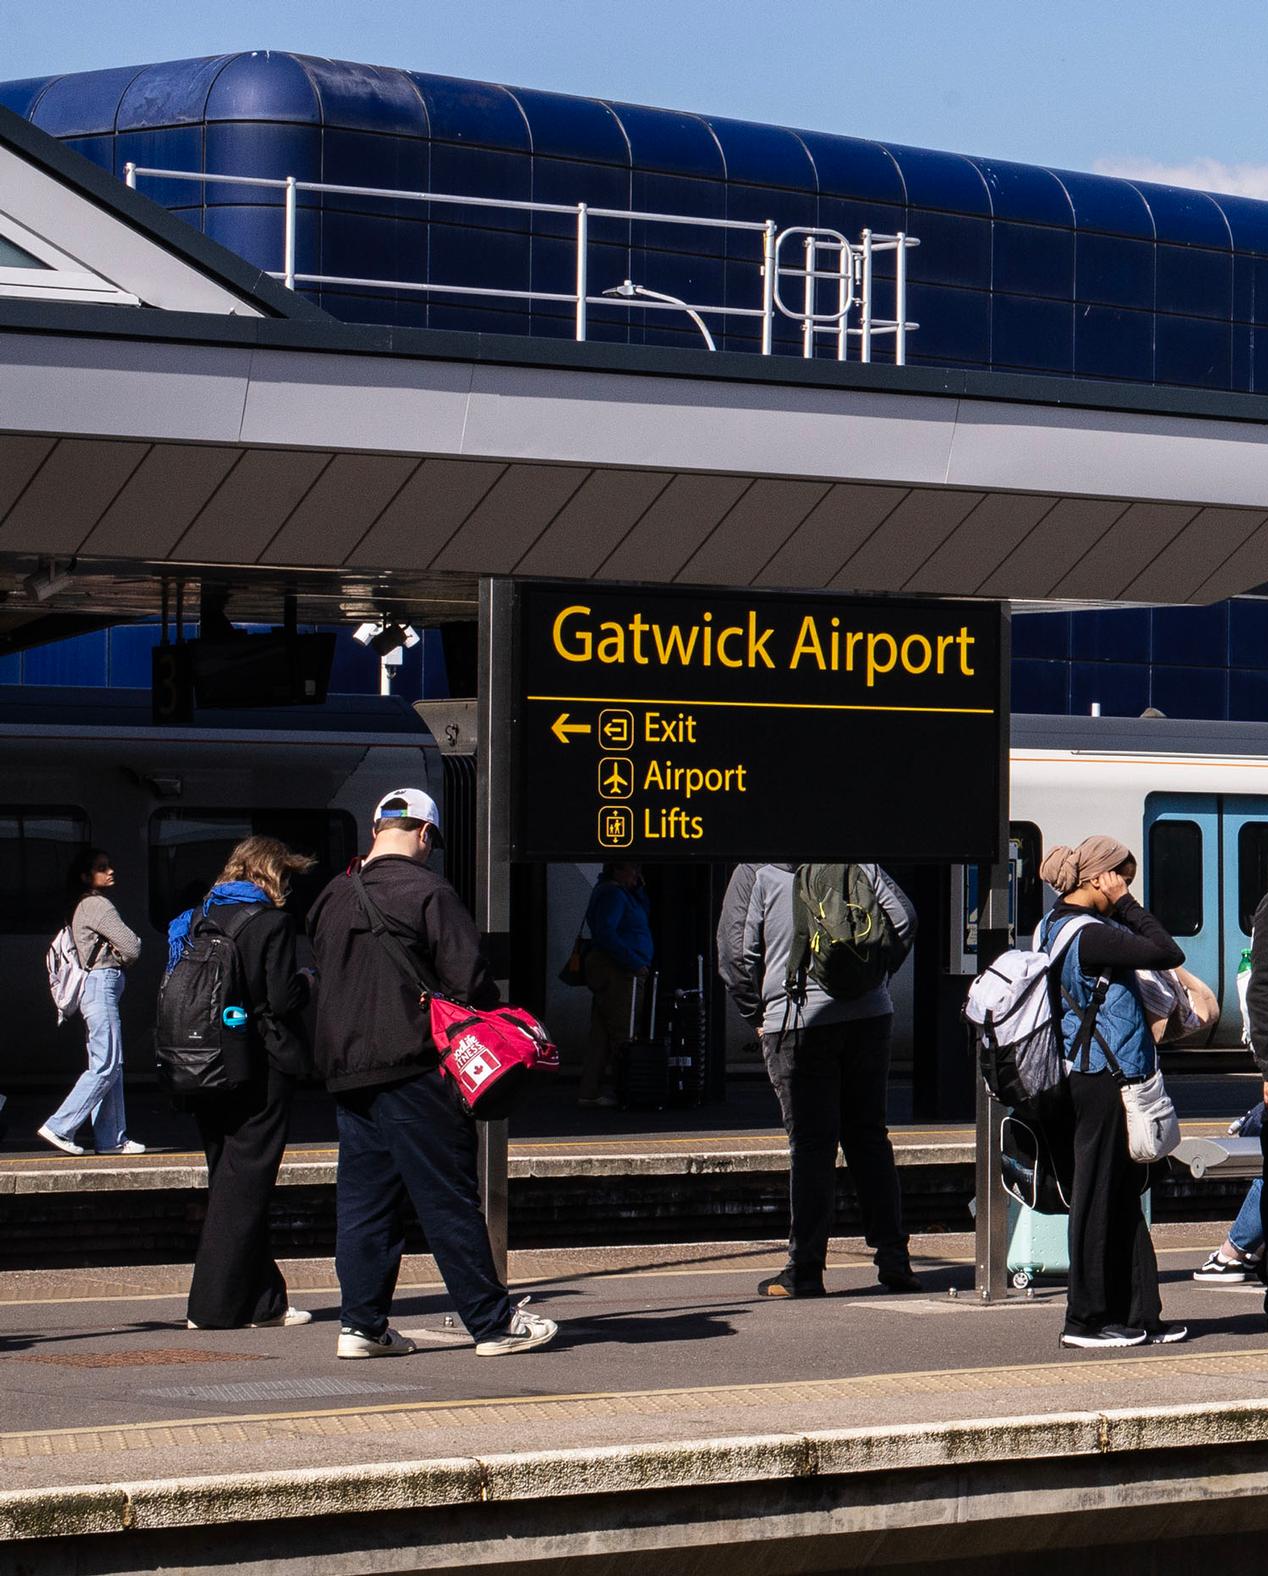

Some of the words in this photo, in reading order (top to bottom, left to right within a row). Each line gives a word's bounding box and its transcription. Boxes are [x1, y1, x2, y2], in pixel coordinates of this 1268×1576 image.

[552, 605, 775, 669] Gatwick
[789, 615, 975, 687] Airport
[644, 712, 697, 743] Exit
[643, 760, 747, 798] Airport
[644, 807, 704, 839] Lifts
